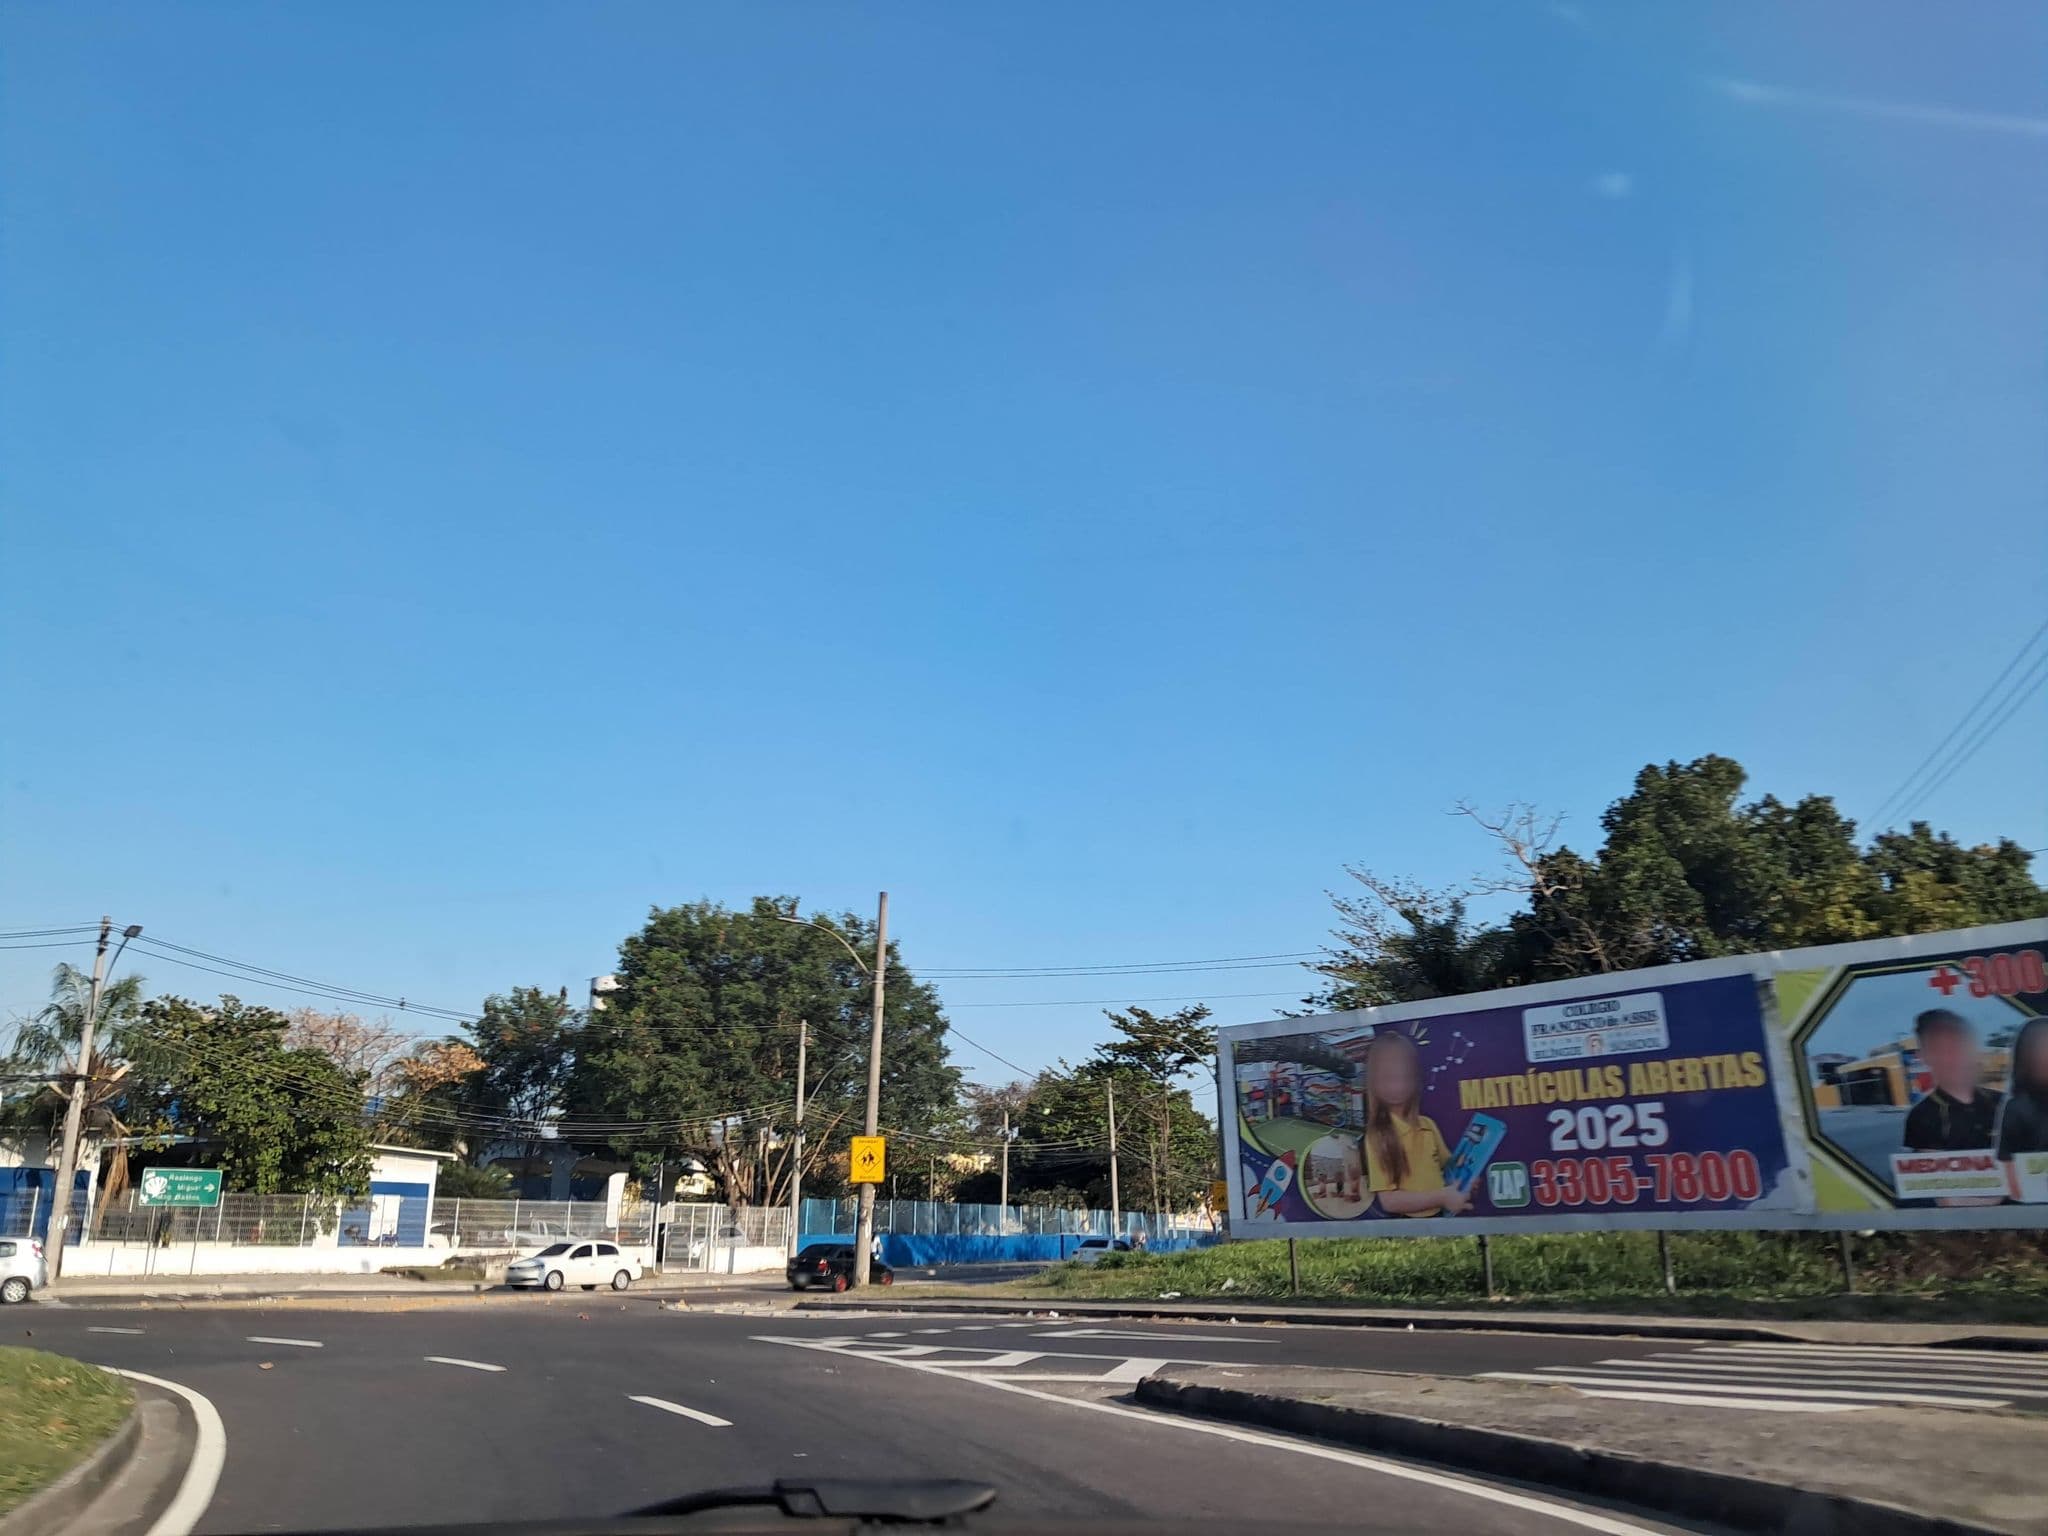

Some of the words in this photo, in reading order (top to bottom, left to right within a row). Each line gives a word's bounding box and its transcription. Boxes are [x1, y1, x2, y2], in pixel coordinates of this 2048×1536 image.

[1459, 1064, 1625, 1109] MATRÍCULAS
[1629, 1052, 1766, 1096] ABERTAS
[1547, 1102, 1668, 1151] 2025
[1491, 1169, 1526, 1201] ZAP
[1531, 1149, 1761, 1206] 3305-7800
